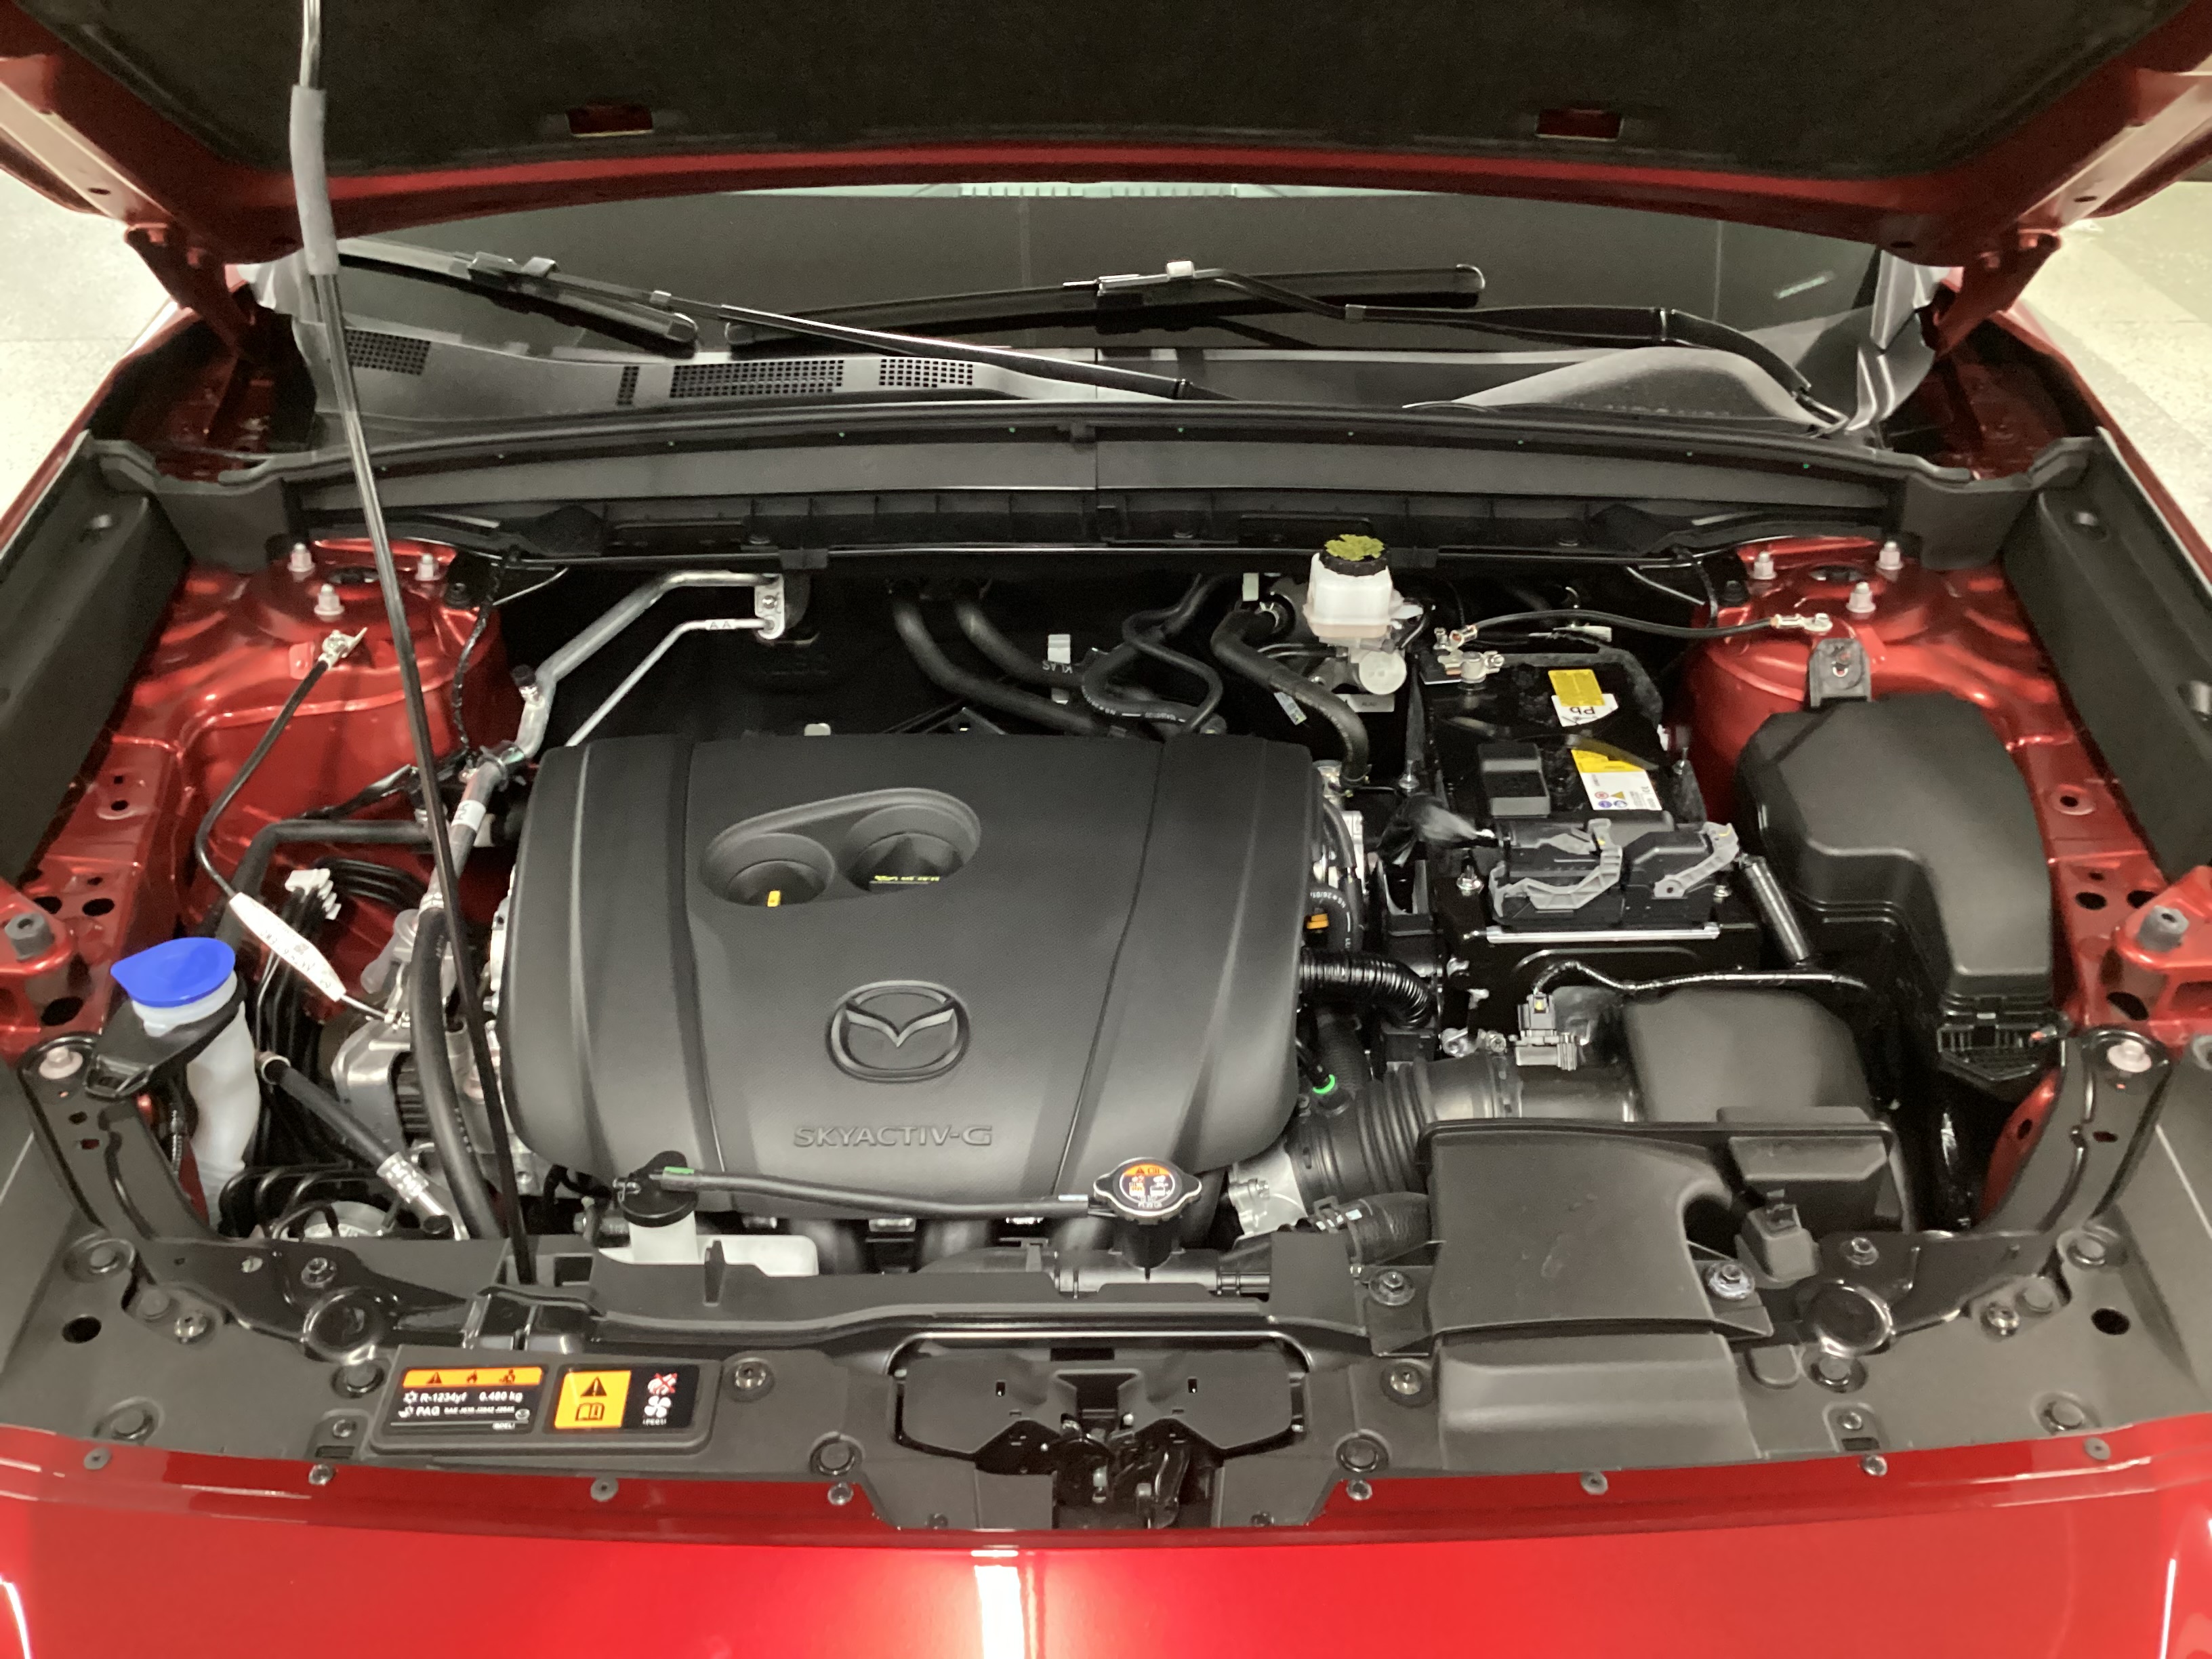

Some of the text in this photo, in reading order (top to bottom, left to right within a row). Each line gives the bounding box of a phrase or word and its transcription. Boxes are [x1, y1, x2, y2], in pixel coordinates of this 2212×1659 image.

[1570, 706, 1596, 715] Pb
[794, 1126, 992, 1147] SKYACTIV-G
[420, 1391, 468, 1404] R-1234yf
[509, 1391, 523, 1403] kg
[416, 1406, 440, 1416] PAG
